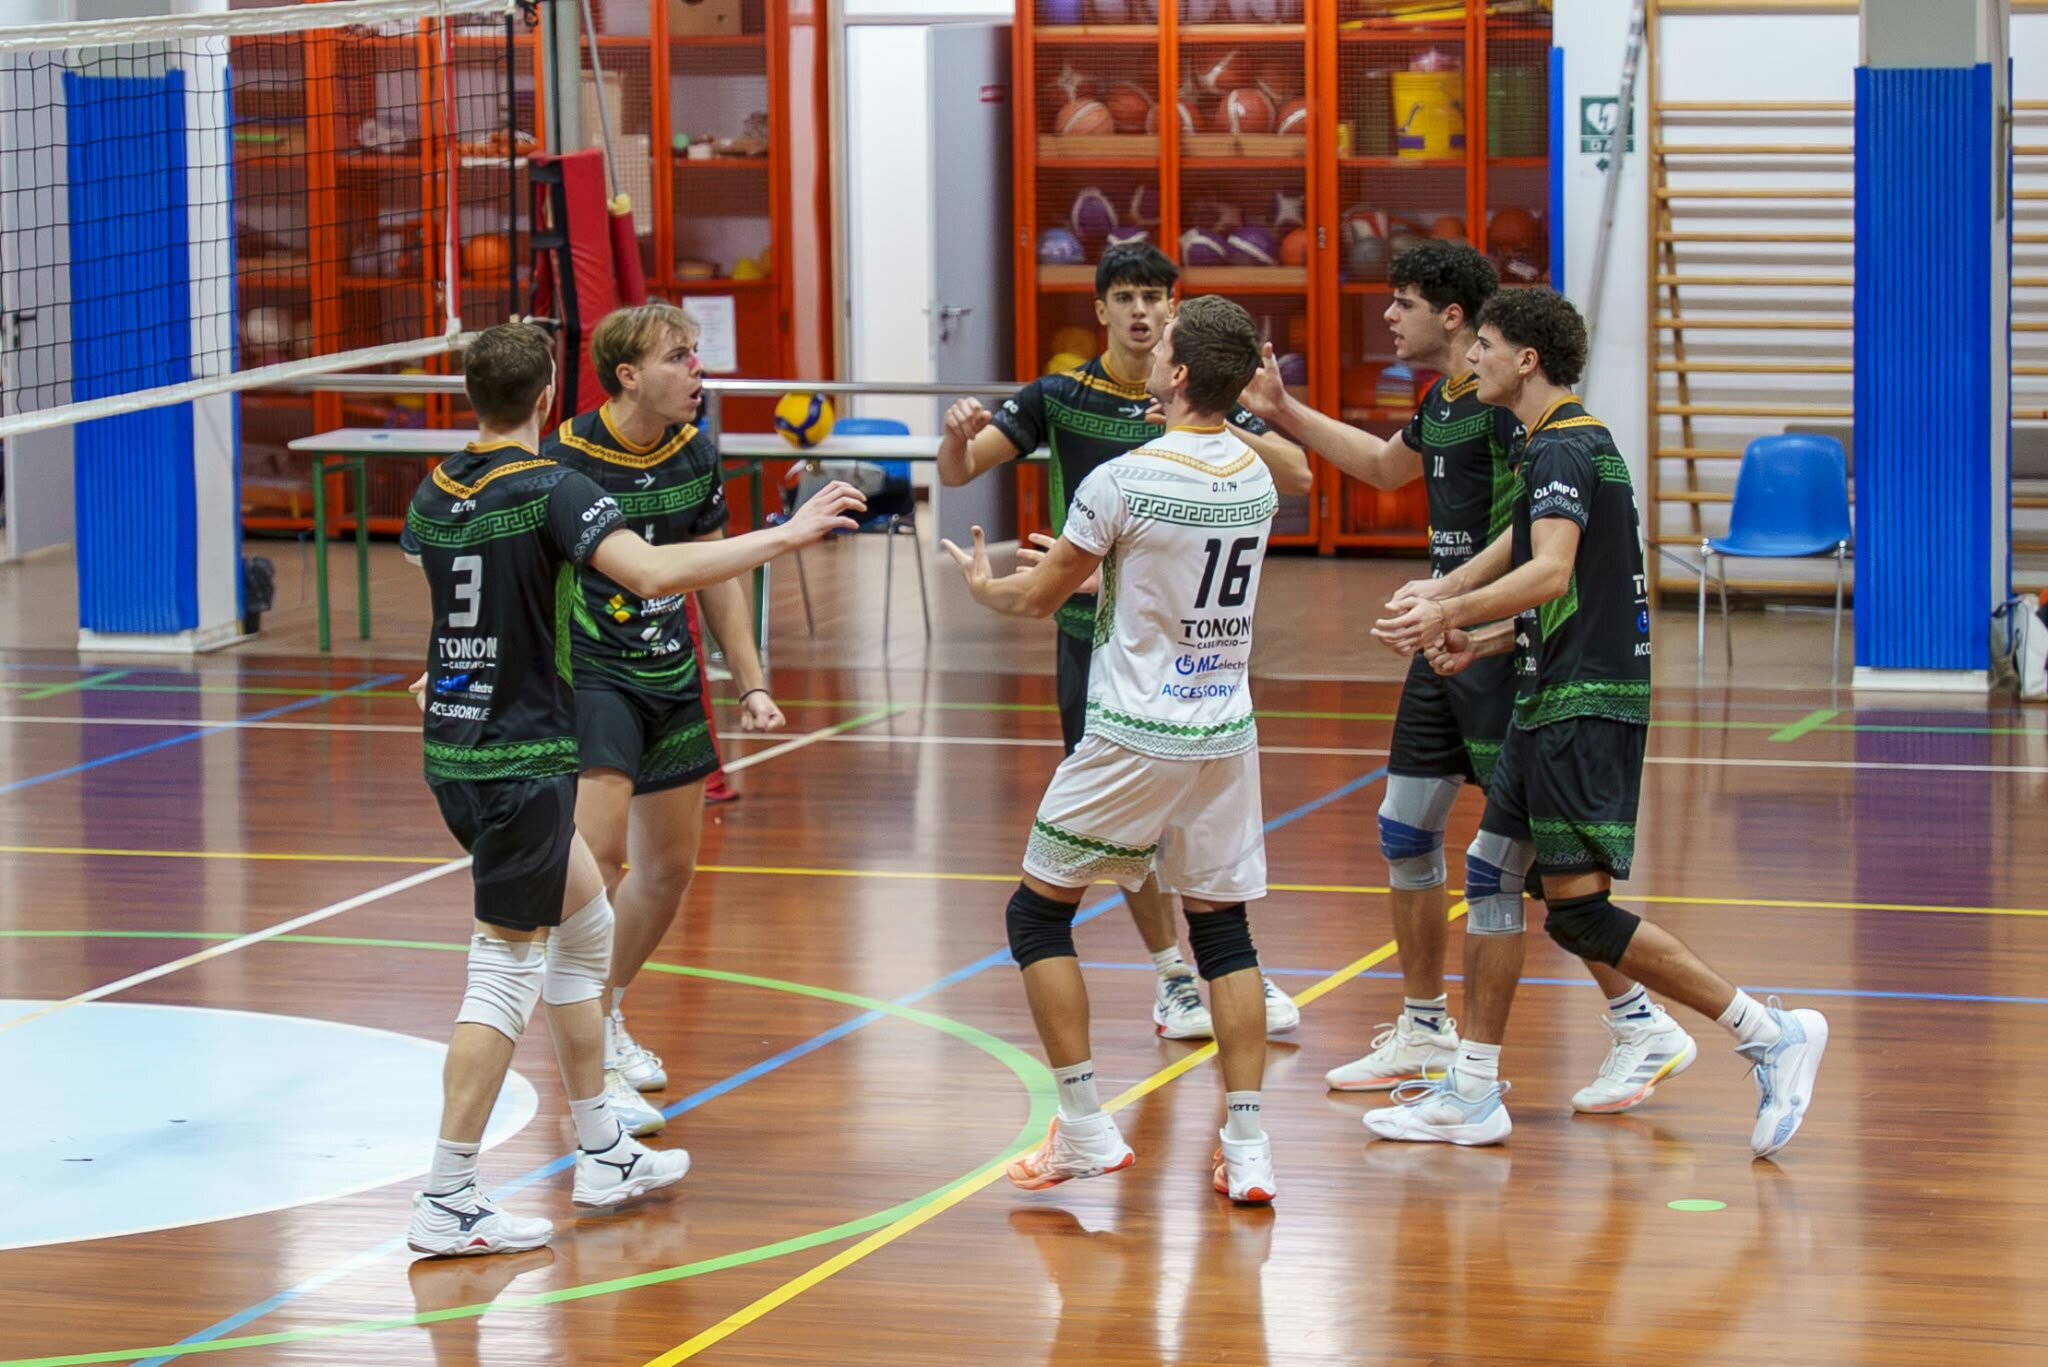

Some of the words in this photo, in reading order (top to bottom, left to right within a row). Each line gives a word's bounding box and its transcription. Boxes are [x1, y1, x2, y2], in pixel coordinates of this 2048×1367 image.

[1534, 480, 1579, 499] OLYMPO
[1194, 536, 1260, 609] 16
[448, 554, 483, 628] 3
[1181, 615, 1250, 639] TONON
[438, 637, 498, 659] TONON
